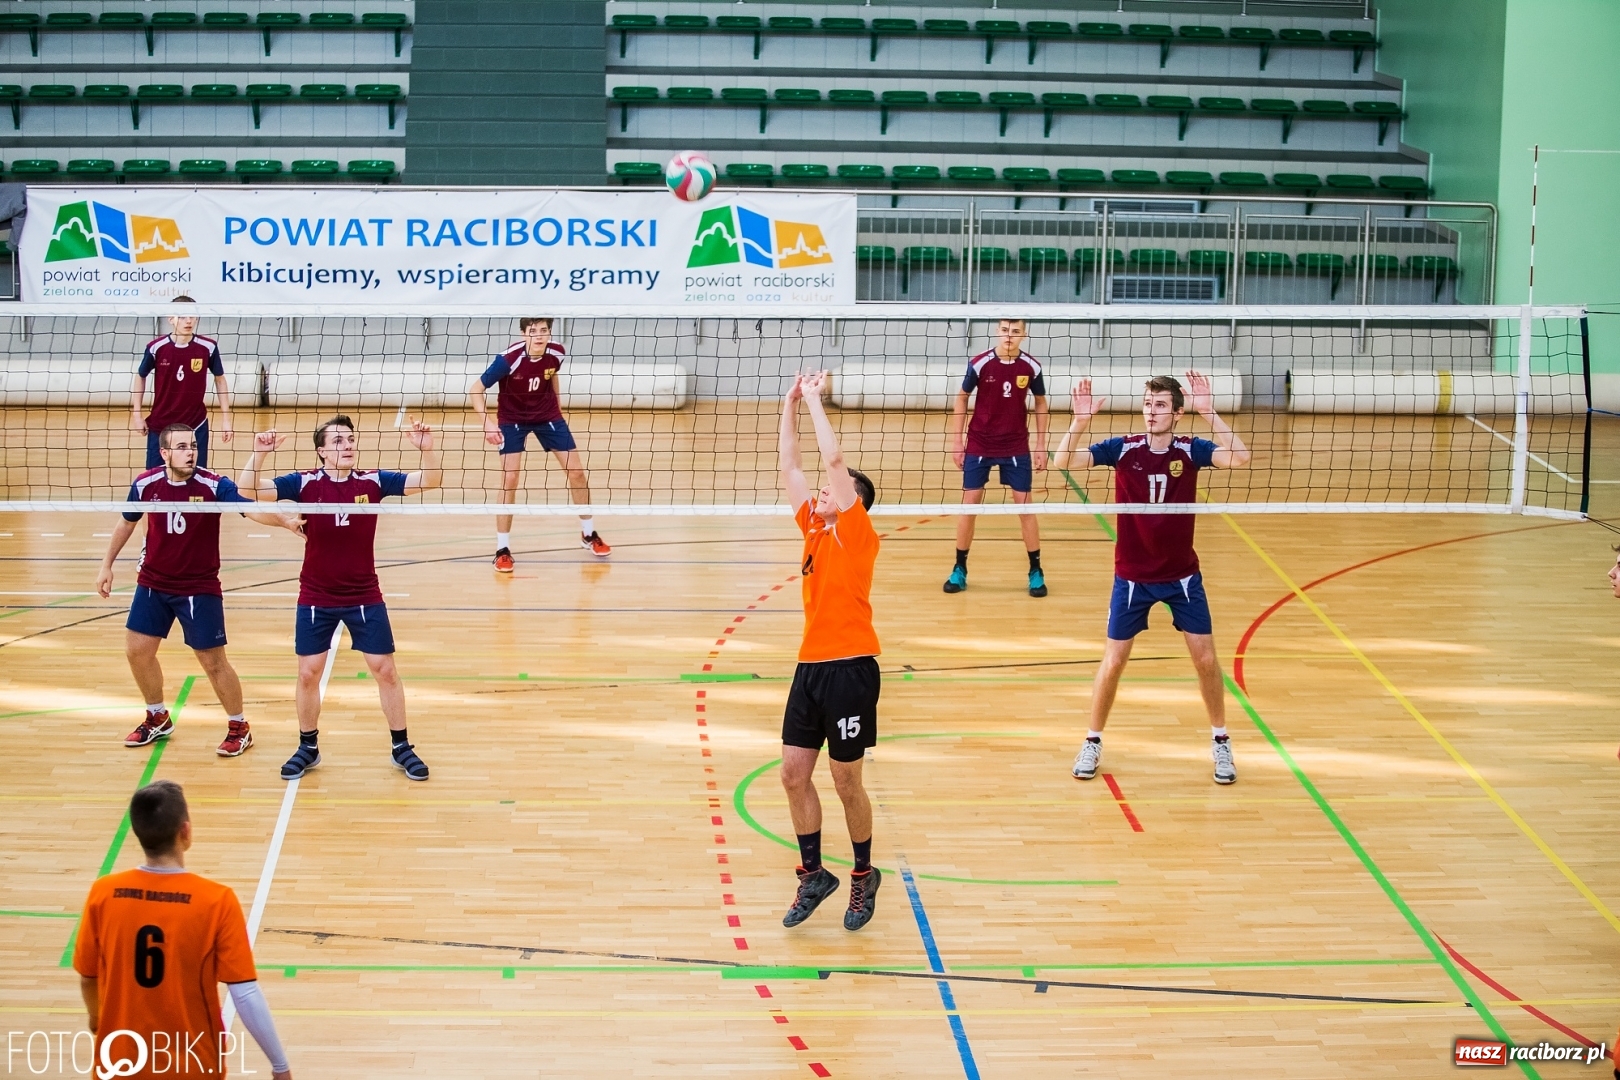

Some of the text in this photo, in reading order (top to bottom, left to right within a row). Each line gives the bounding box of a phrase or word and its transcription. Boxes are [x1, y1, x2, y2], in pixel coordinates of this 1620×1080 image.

[225, 217, 657, 247] POWIAT RACIBORSKI
[43, 267, 191, 285] powiat raciborski
[221, 261, 660, 291] kibicujemy, wspieramy, gramy
[685, 273, 834, 290] powiat raciborski
[43, 286, 93, 296] zielona
[104, 287, 139, 296] oaza
[685, 292, 735, 302] zielona
[746, 293, 781, 302] oaza
[176, 365, 184, 382] 6
[528, 377, 541, 392] 10
[1003, 381, 1012, 398] 2
[1147, 473, 1168, 504] 17
[166, 512, 187, 535] 16
[837, 715, 861, 740] 15
[134, 924, 165, 989] 6
